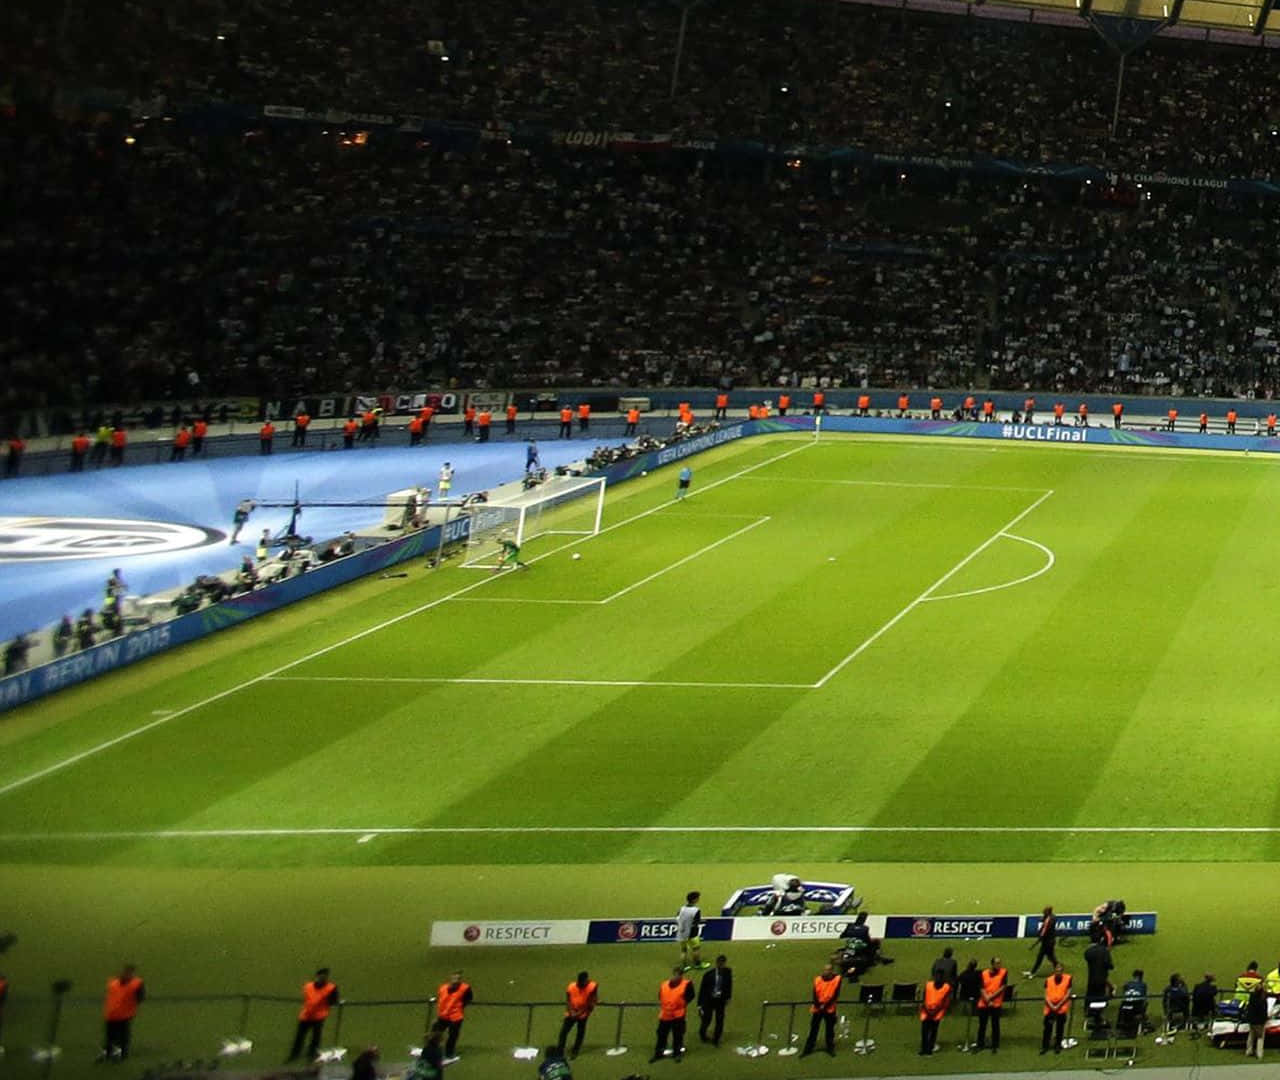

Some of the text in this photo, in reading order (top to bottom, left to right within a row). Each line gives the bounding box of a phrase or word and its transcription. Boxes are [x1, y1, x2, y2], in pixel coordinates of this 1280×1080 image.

[1003, 425, 1087, 441] #UCLFinal
[485, 926, 552, 940] RESPECT
[640, 923, 706, 938] RESPT
[933, 921, 993, 934] RESPECT
